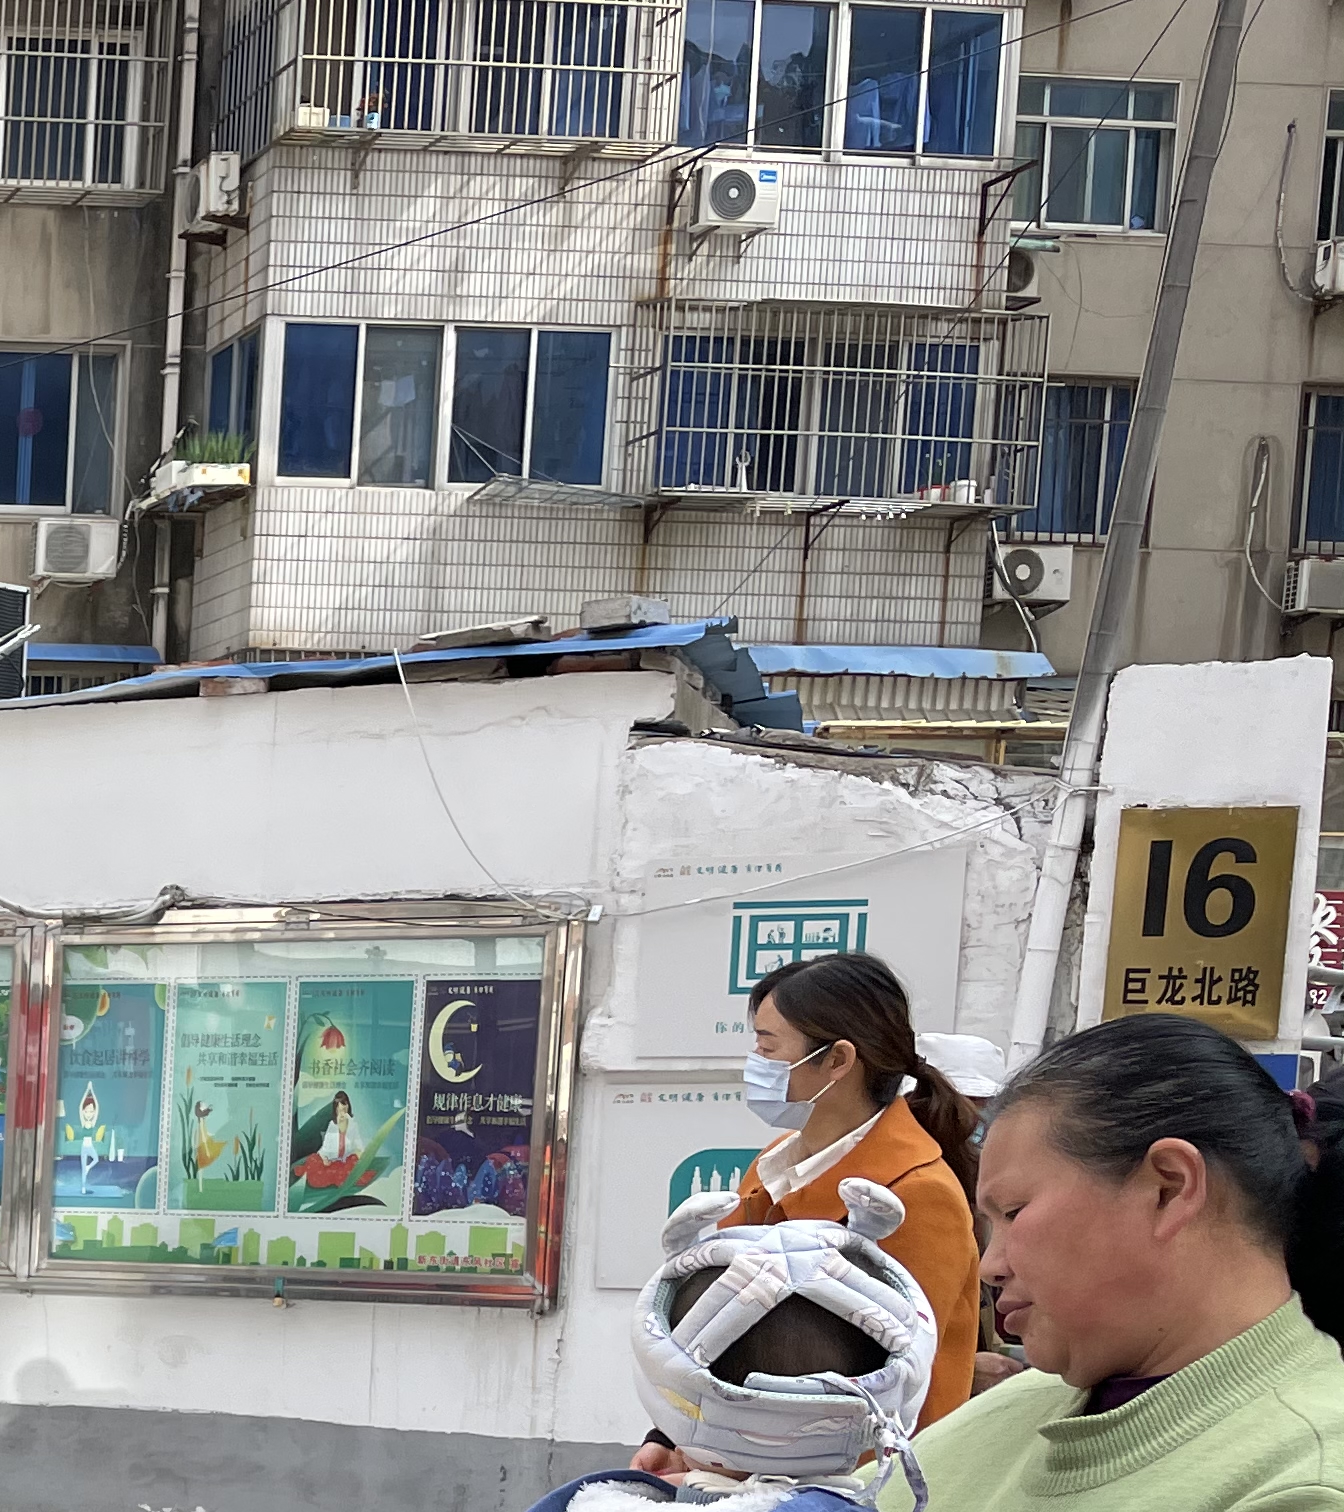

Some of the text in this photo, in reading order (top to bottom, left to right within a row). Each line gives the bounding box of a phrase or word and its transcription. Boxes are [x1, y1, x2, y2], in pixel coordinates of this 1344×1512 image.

[1141, 837, 1257, 938] 16
[1122, 966, 1260, 1007] 巨龙北路
[181, 1033, 261, 1048] 倡导健康生活理念
[197, 1051, 278, 1067] 共享和谐幸福生活
[310, 1058, 396, 1078] 书香社会齐阅读
[432, 1091, 523, 1113] 规律作息才健康
[417, 1254, 505, 1270] 新东街道东风社区
